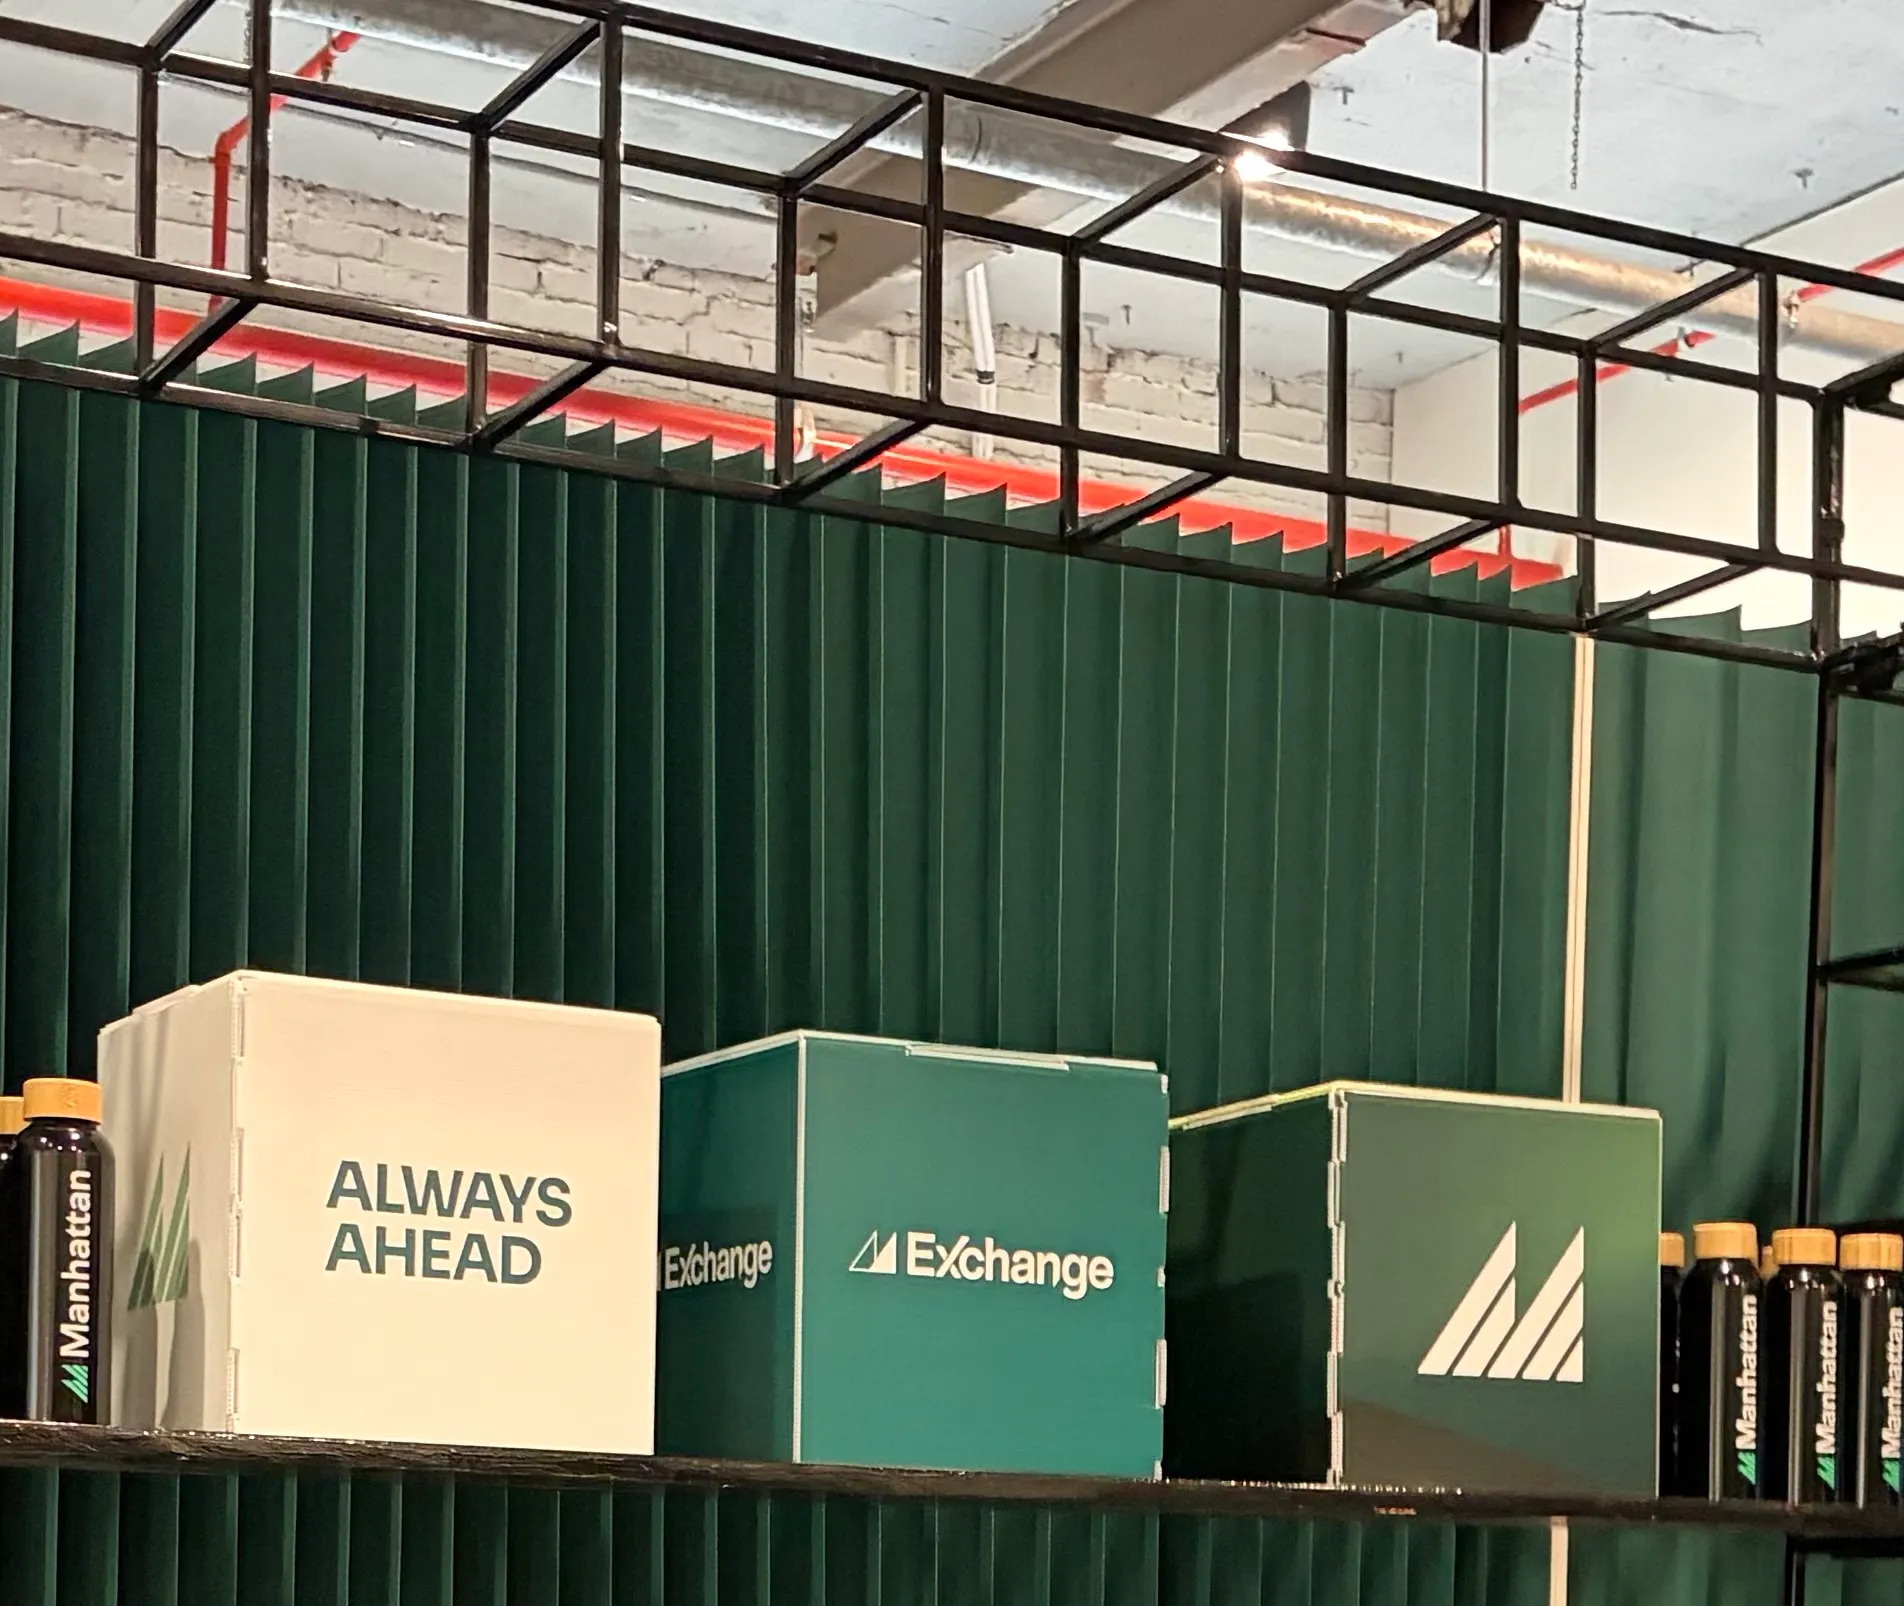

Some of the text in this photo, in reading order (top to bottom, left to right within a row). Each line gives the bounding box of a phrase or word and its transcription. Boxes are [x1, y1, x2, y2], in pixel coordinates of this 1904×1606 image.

[325, 1159, 573, 1228] ALWAYS
[60, 1169, 92, 1359] Manhattan
[324, 1222, 543, 1286] AHEAD
[664, 1238, 773, 1291] Exchange
[907, 1231, 1115, 1301] Exchange
[1735, 1294, 1758, 1450] Manhattan
[1815, 1300, 1839, 1455] Manhattan
[1880, 1305, 1904, 1459] Manhattan
